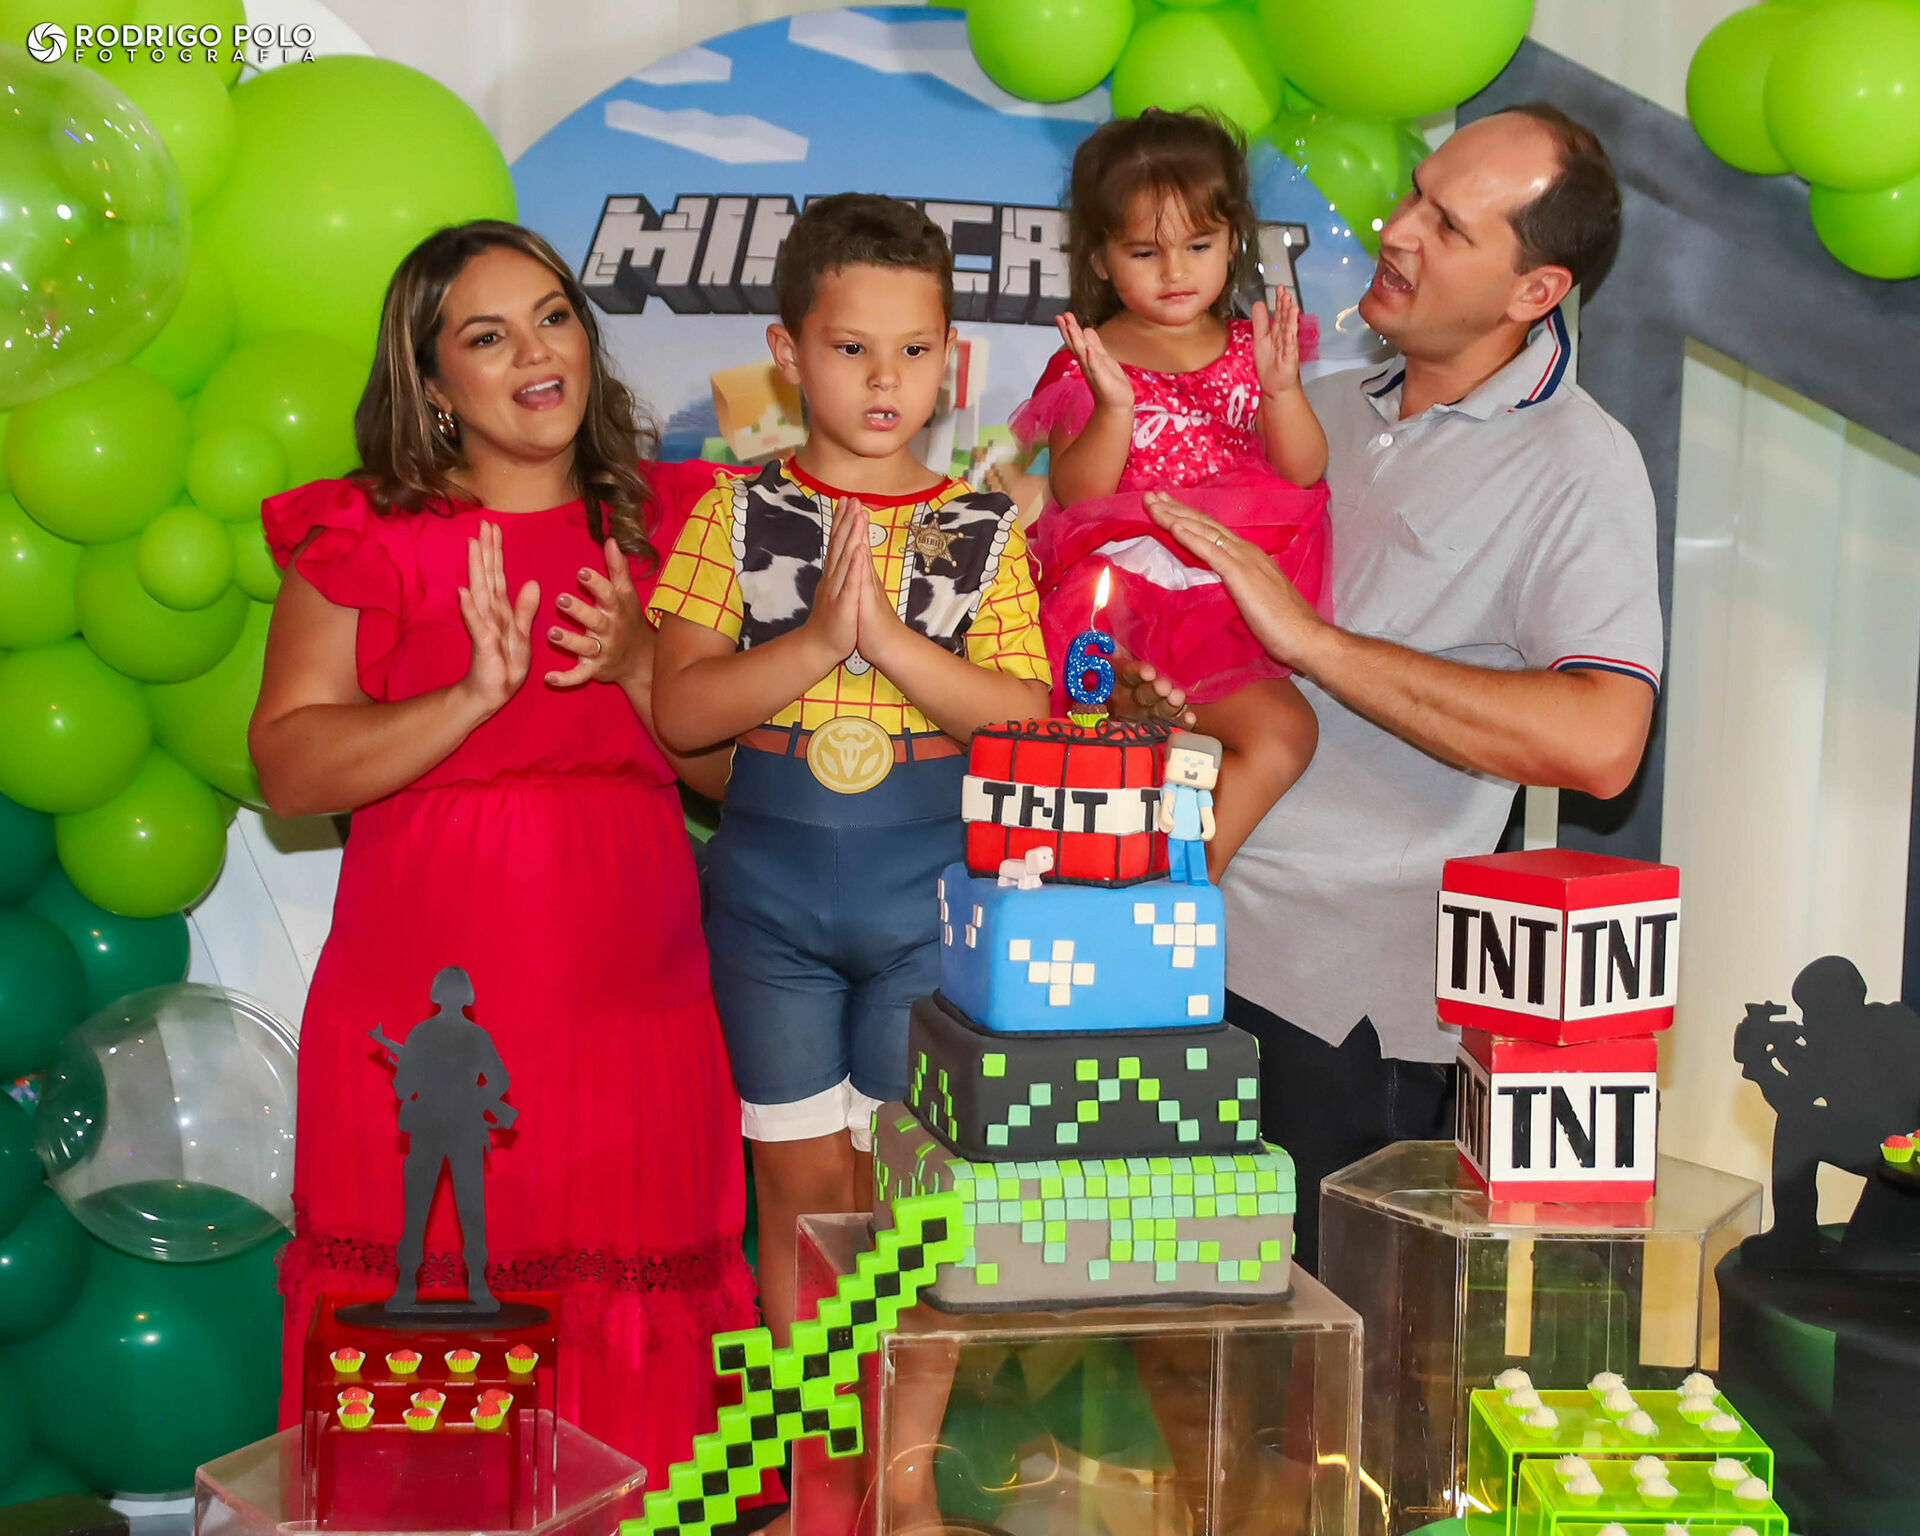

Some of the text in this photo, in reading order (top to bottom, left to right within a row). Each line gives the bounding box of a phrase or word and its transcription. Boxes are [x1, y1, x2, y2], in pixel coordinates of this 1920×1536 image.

[579, 194, 1310, 325] MINCRT
[1064, 629, 1115, 705] 6
[982, 780, 1109, 834] TNT
[1441, 903, 1558, 1005] TNT
[1571, 911, 1678, 1007] TNT
[1455, 1055, 1488, 1167] TNT
[1497, 1085, 1651, 1169] TNT
